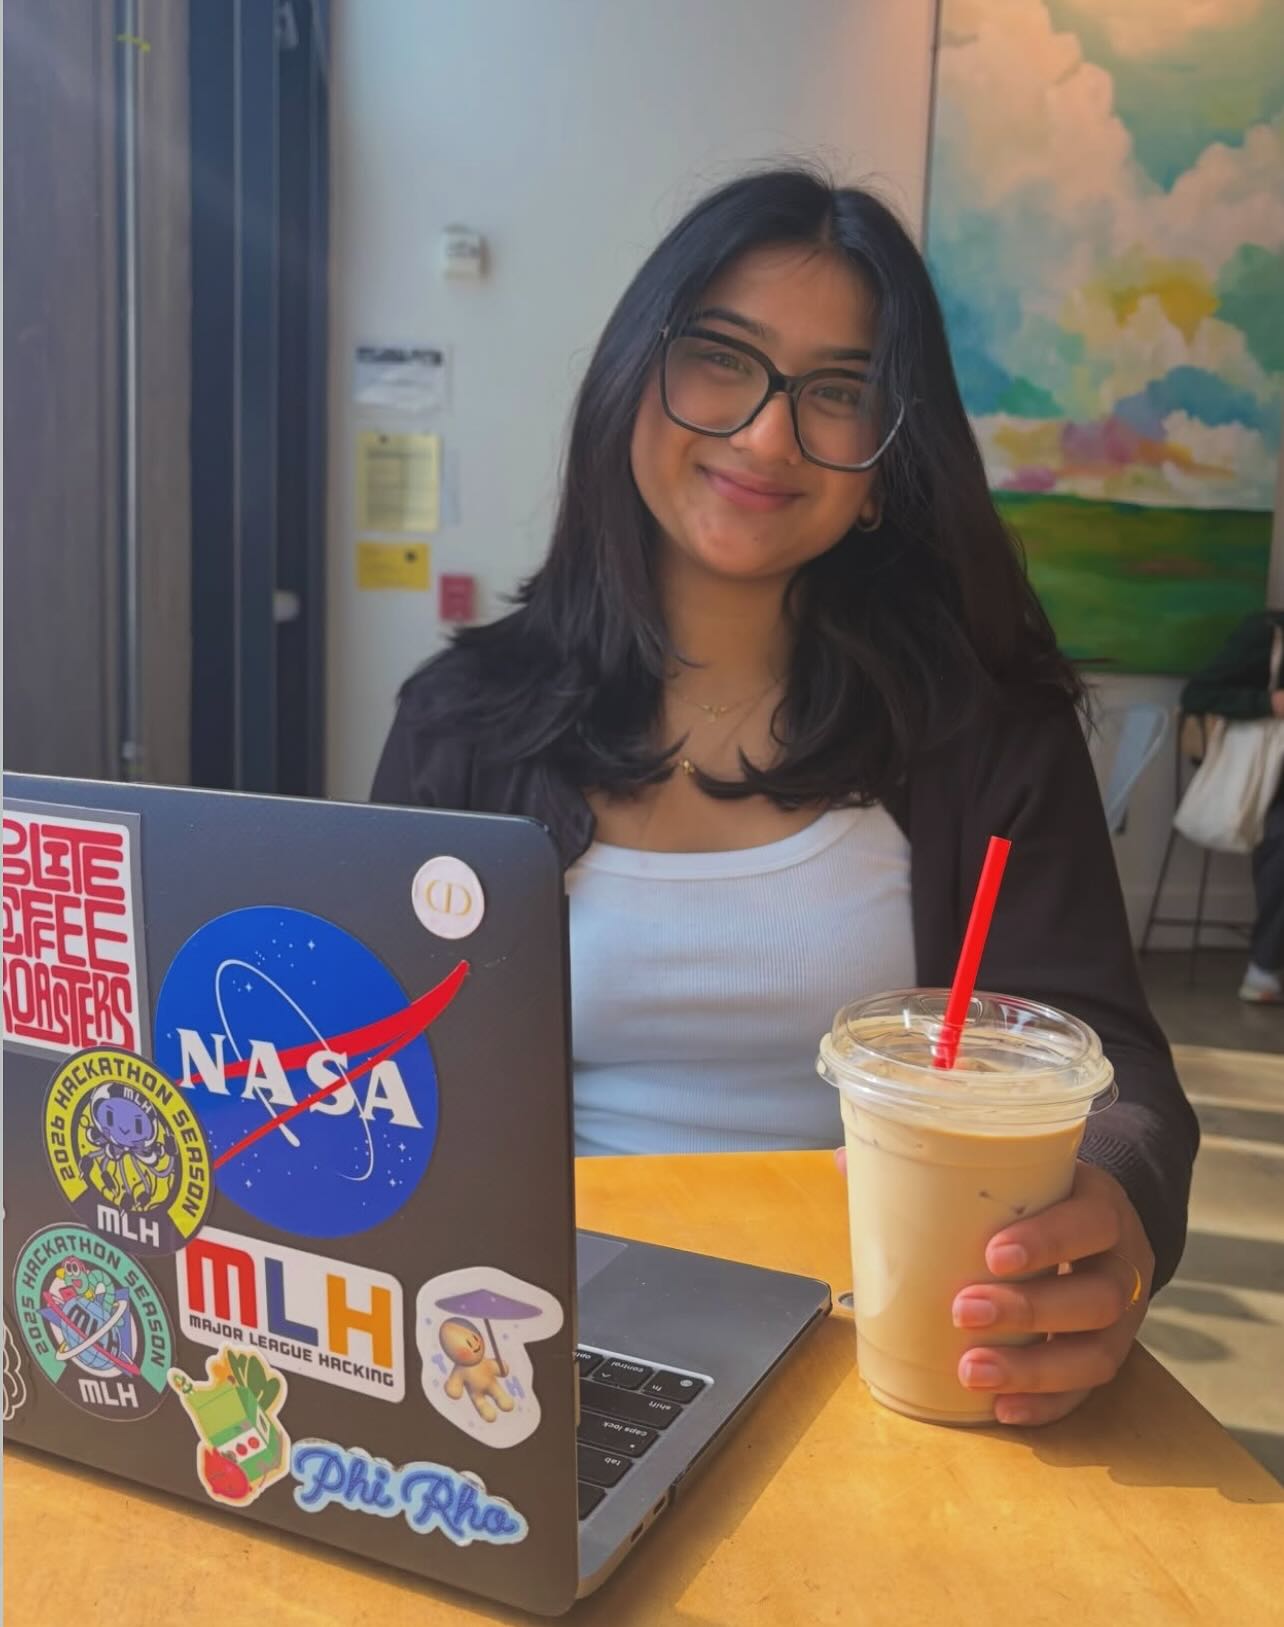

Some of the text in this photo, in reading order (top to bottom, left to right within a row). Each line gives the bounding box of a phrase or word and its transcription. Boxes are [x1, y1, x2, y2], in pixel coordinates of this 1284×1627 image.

[123, 1087, 152, 1113] MLH
[175, 1027, 424, 1129] NASA
[51, 1057, 205, 1218] 2026 HACKATHON SEASON
[97, 1204, 160, 1248] MLH
[22, 1235, 166, 1367] 2025 HACKATHON SEASON
[185, 1238, 393, 1370] MLH
[189, 1314, 395, 1387] MAJOR LEAGUE HACKING
[78, 1379, 139, 1408] MLH
[648, 1400, 671, 1410] shift
[603, 1421, 648, 1437] caps lock
[604, 1457, 621, 1467] tab
[295, 1447, 520, 1538] Phi Rho
